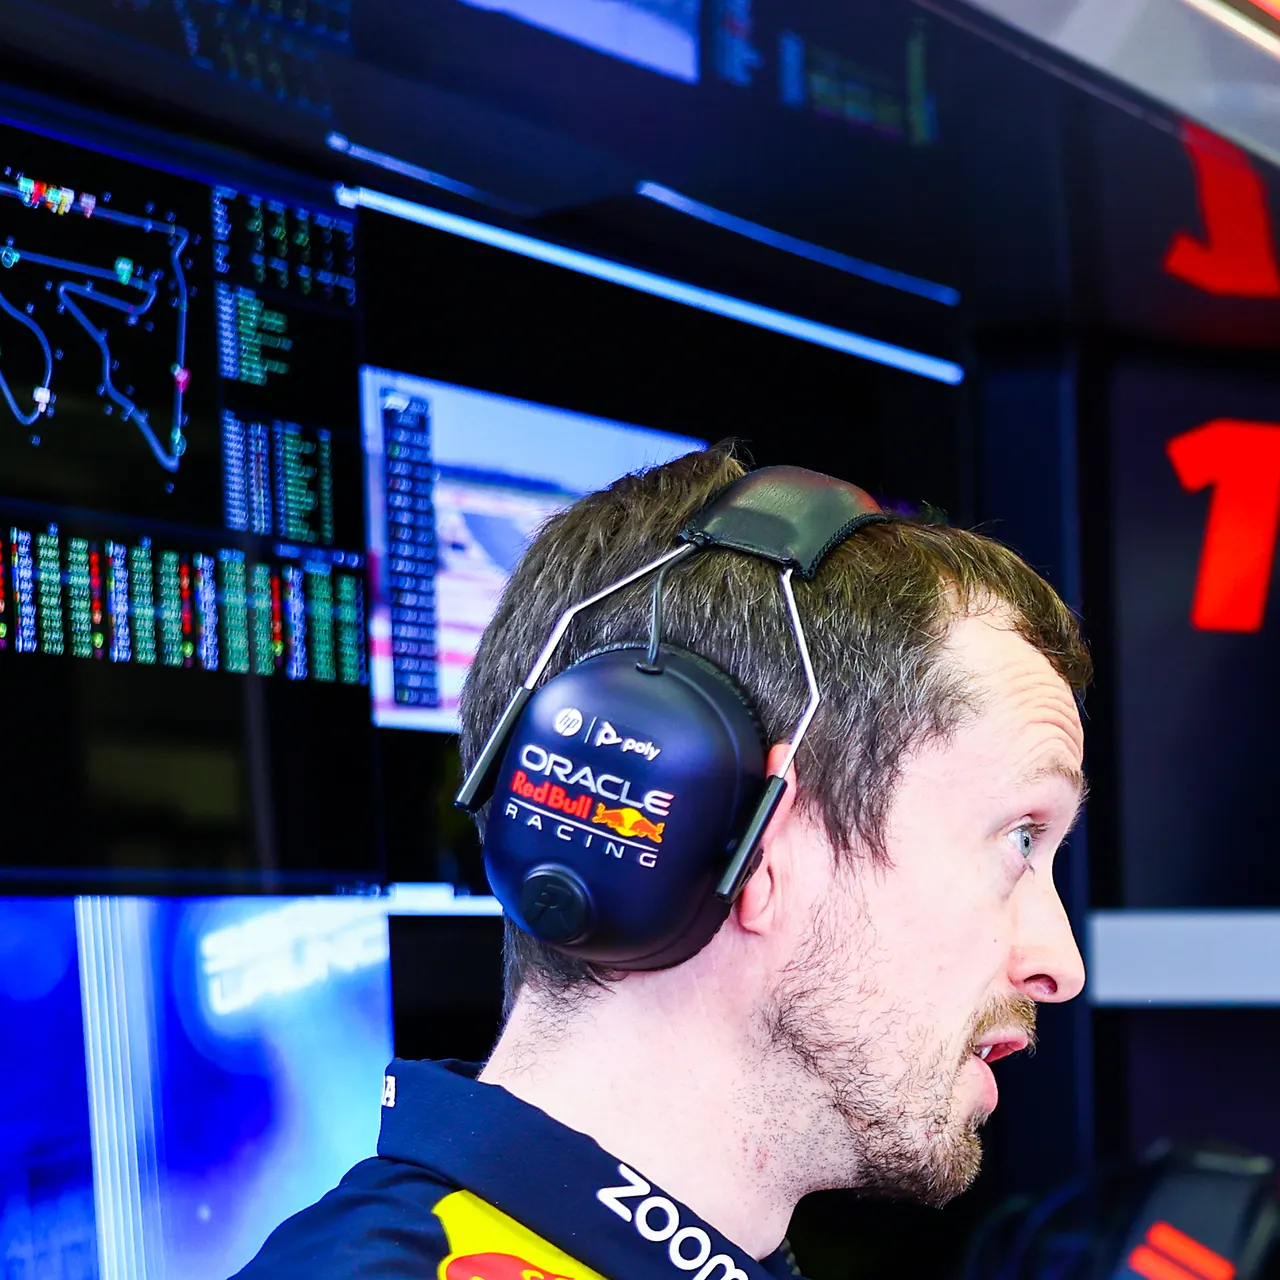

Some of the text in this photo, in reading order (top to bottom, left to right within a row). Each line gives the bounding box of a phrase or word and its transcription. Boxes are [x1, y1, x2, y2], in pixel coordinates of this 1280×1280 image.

[520, 744, 675, 817] ORACLE
[620, 738, 661, 761] poly
[505, 803, 658, 868] RACING
